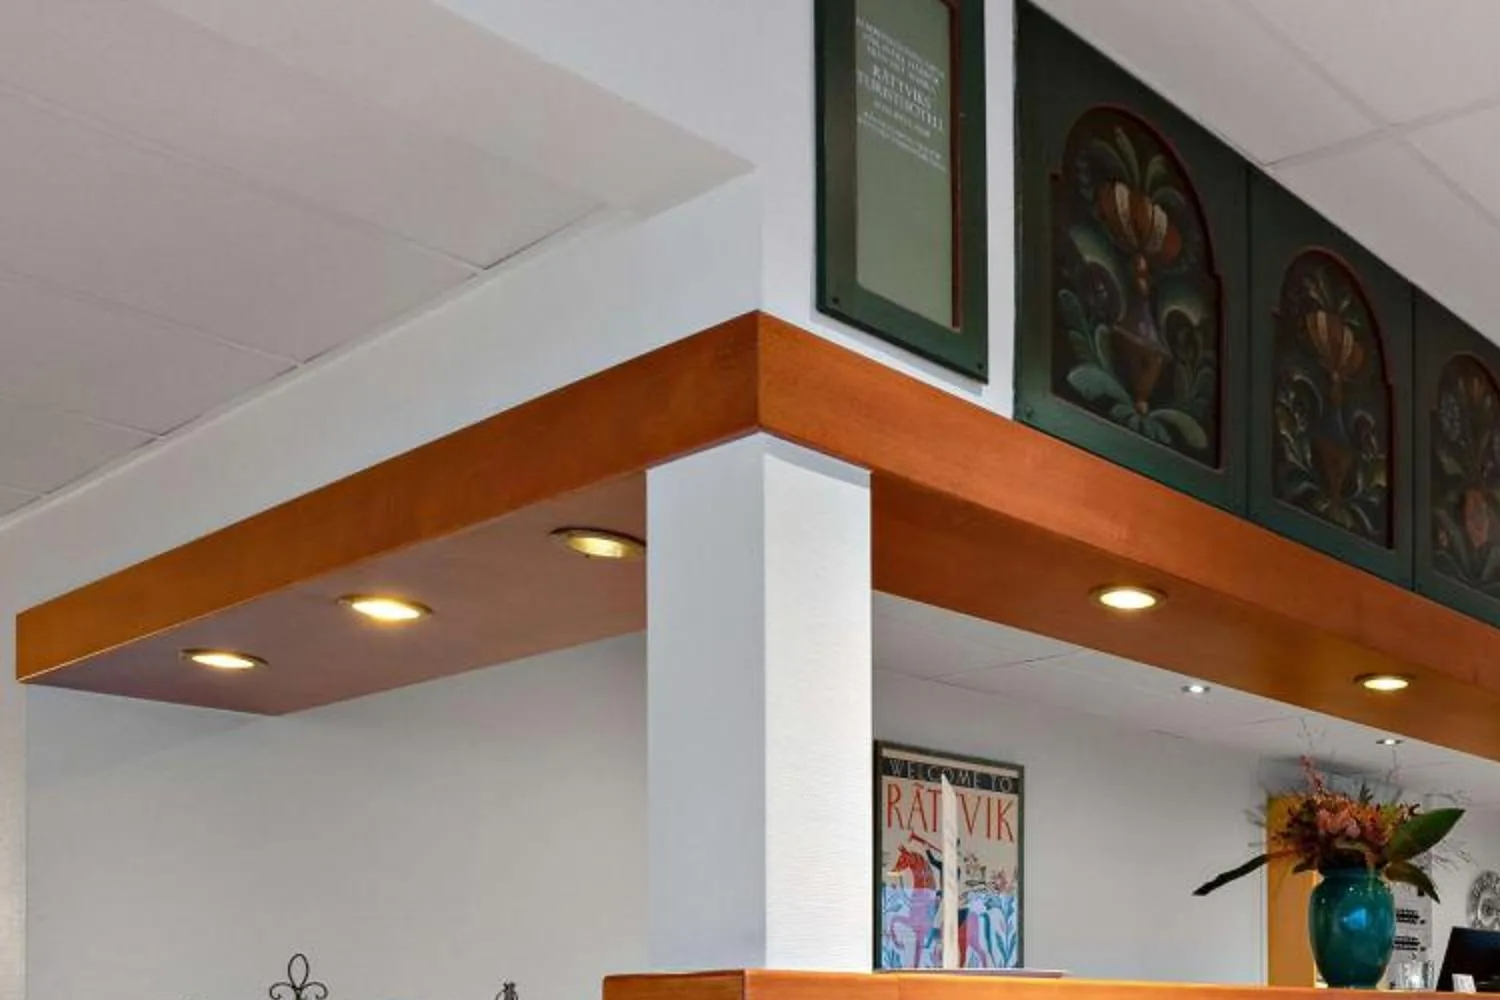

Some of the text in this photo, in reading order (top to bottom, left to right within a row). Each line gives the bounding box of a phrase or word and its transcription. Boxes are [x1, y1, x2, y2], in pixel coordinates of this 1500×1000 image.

[889, 759, 1013, 793] WELCOME TO
[886, 782, 1014, 843] RÄTVIK
